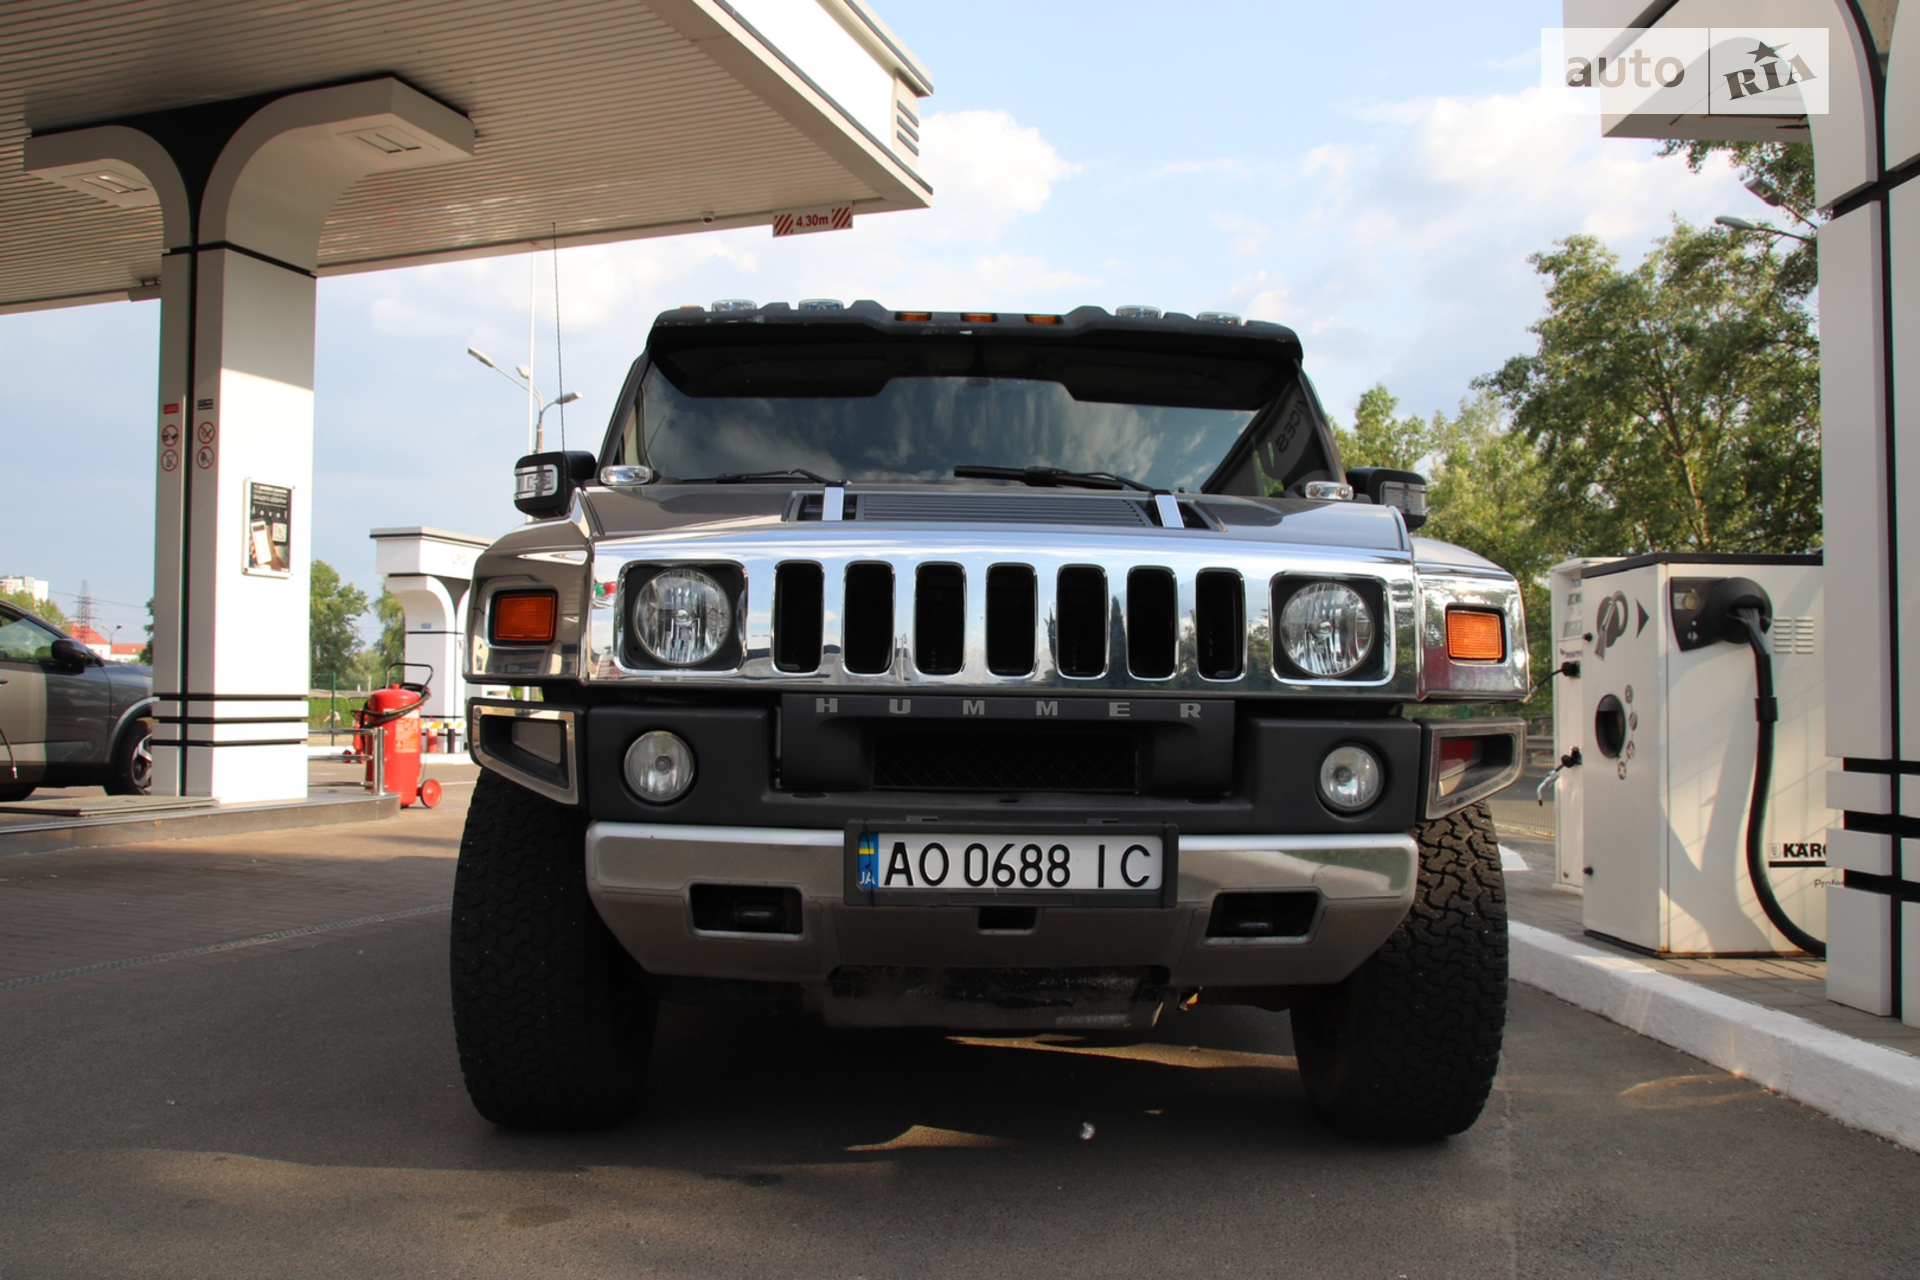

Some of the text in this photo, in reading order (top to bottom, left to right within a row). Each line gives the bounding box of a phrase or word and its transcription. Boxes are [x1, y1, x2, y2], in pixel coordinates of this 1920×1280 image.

[816, 698, 1202, 718] HUMMER
[1783, 843, 1826, 858] KÄR
[884, 841, 1151, 888] AO 0688 IC
